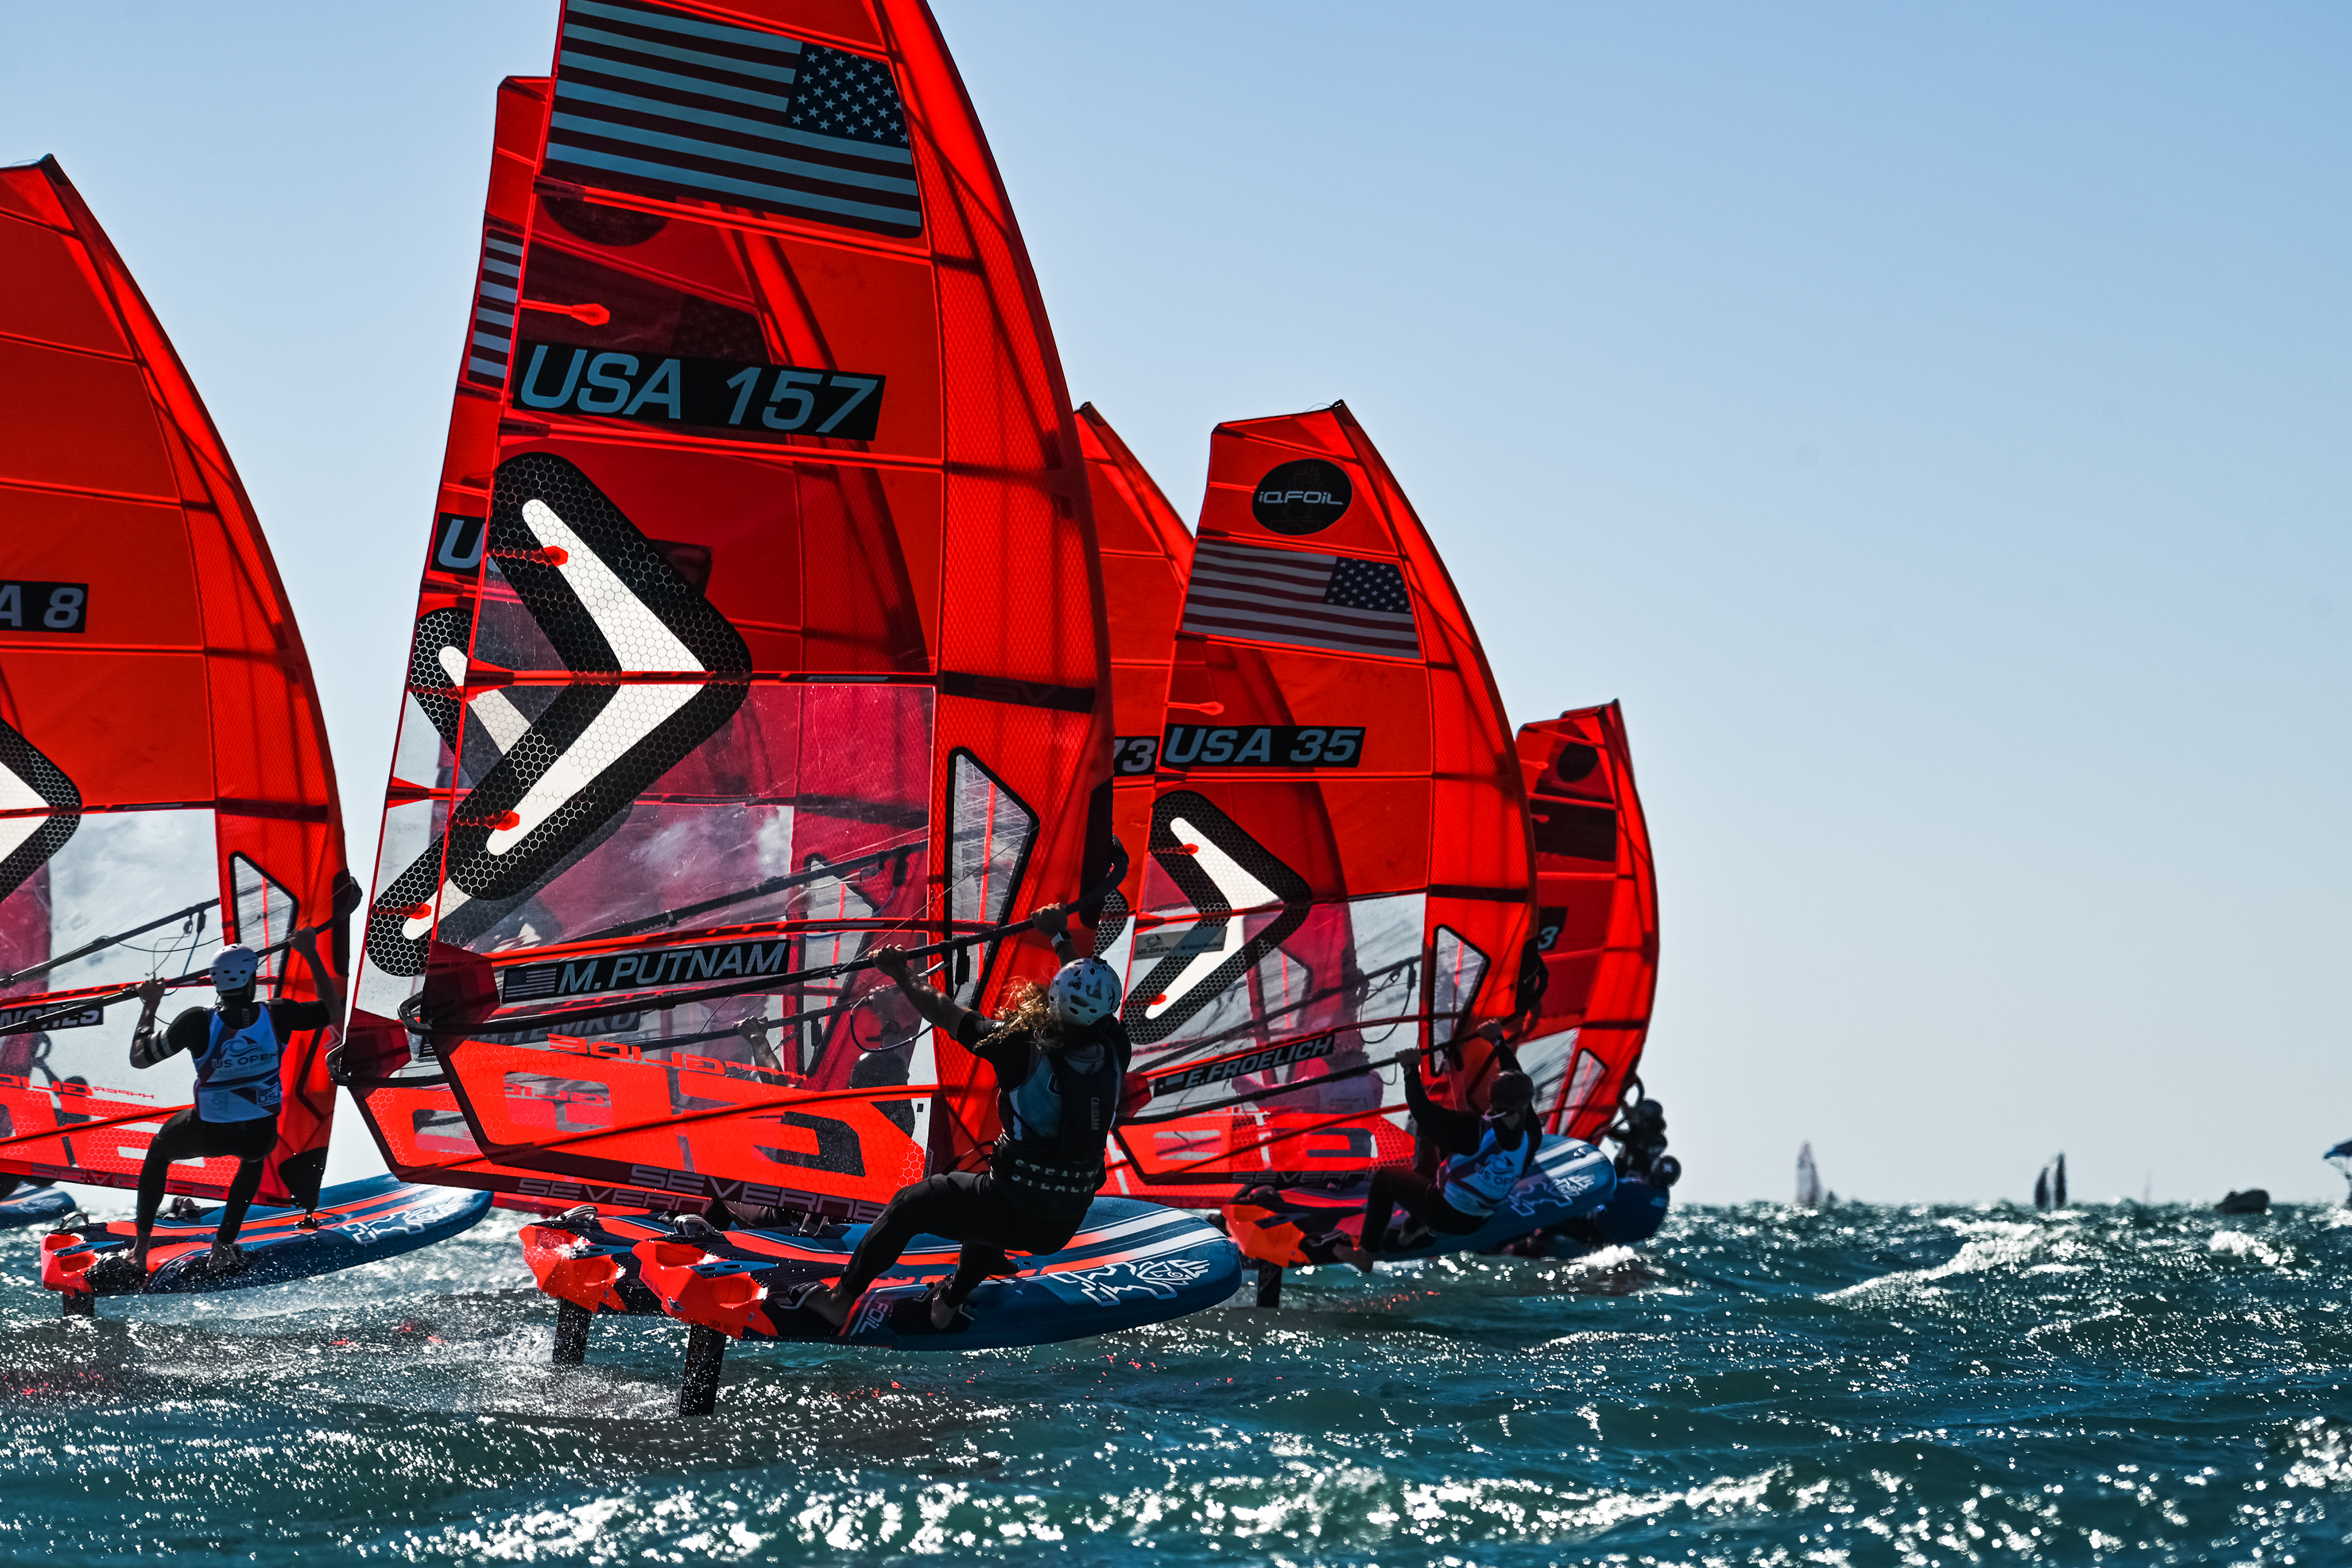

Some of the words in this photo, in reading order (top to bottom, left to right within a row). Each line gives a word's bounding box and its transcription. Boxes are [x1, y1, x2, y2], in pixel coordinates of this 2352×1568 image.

[521, 345, 680, 419] USA
[726, 367, 878, 434] 157
[43, 587, 84, 628] 8
[1165, 728, 1272, 763] USA
[1289, 729, 1362, 762] 35
[558, 960, 601, 994] M.
[609, 942, 786, 989] PUTNAM
[212, 1059, 233, 1069] US
[1185, 1036, 1333, 1088] E.FROELICH
[1091, 1097, 1099, 1131] CAMELBAK
[1231, 1170, 1376, 1183] SEVERN
[516, 1177, 710, 1214] SEVERN
